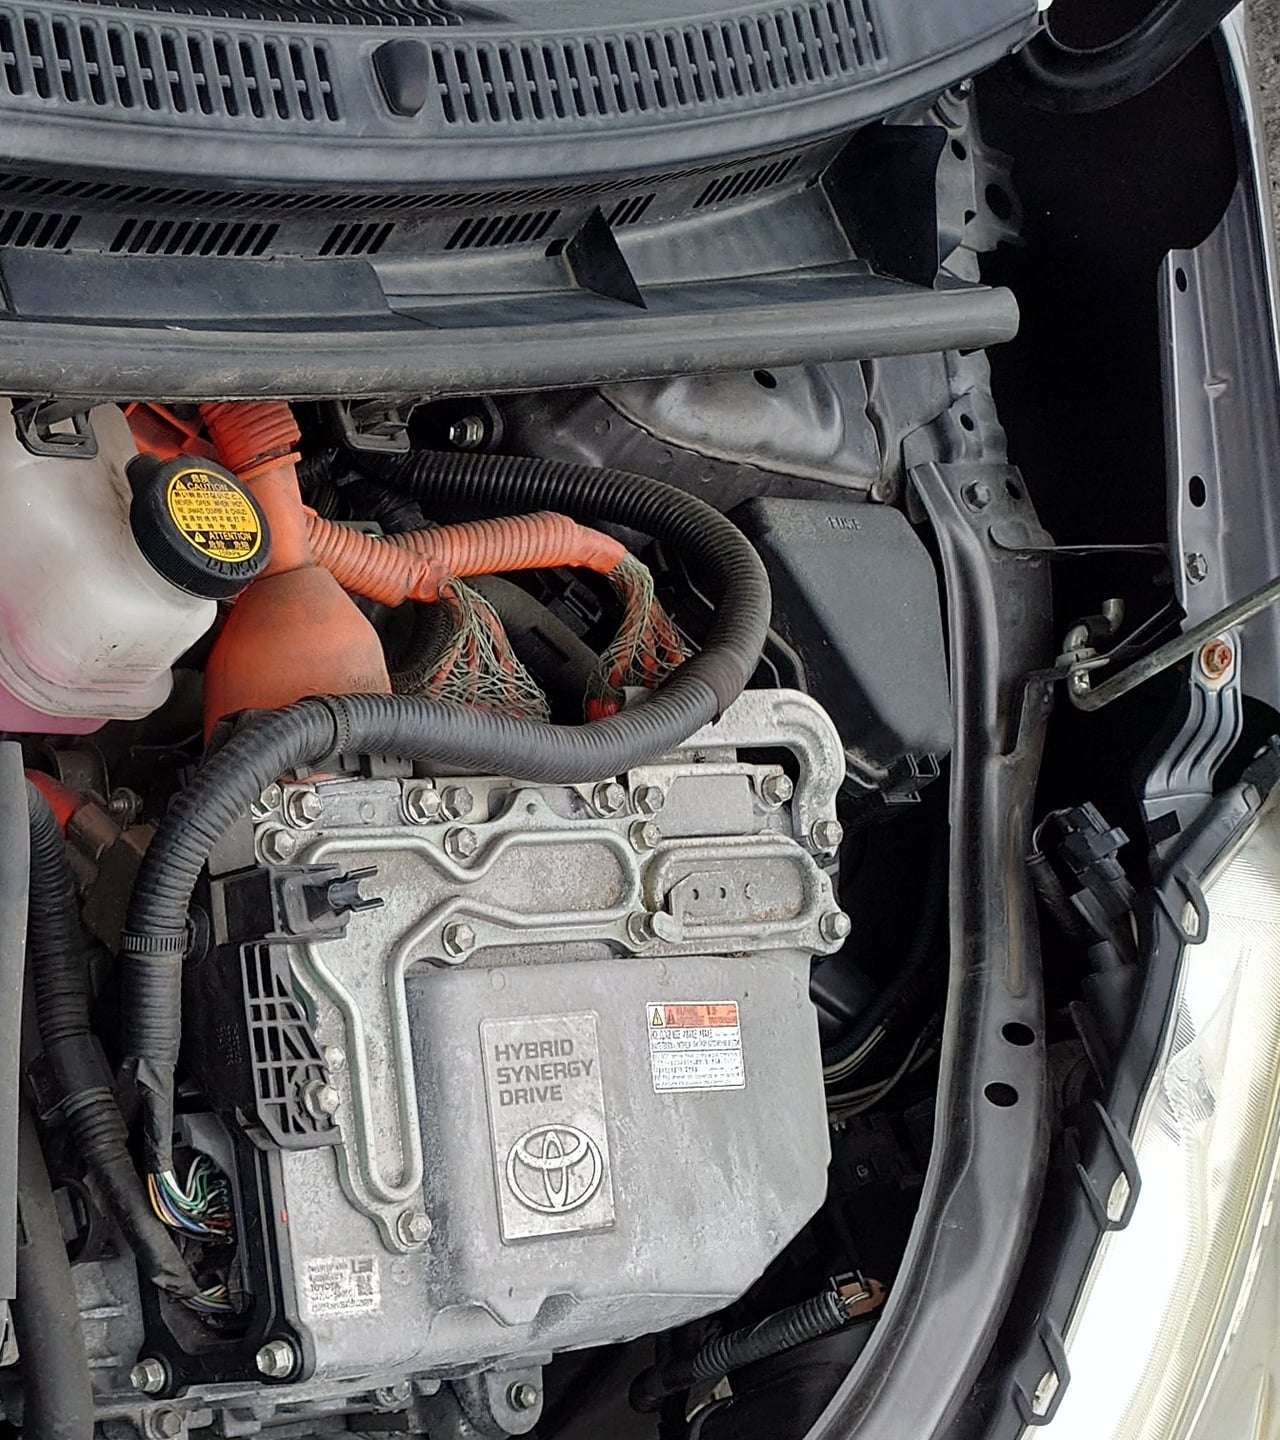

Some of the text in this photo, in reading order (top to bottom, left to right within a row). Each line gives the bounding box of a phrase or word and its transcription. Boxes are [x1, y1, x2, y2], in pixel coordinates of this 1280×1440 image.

[187, 483, 229, 491] CAUTION
[209, 531, 252, 541] ATTENTION
[205, 558, 259, 577] DENSO
[494, 1039, 574, 1062] HYBRID
[497, 1058, 594, 1085] SYNERGY
[499, 1085, 564, 1107] DRIVE
